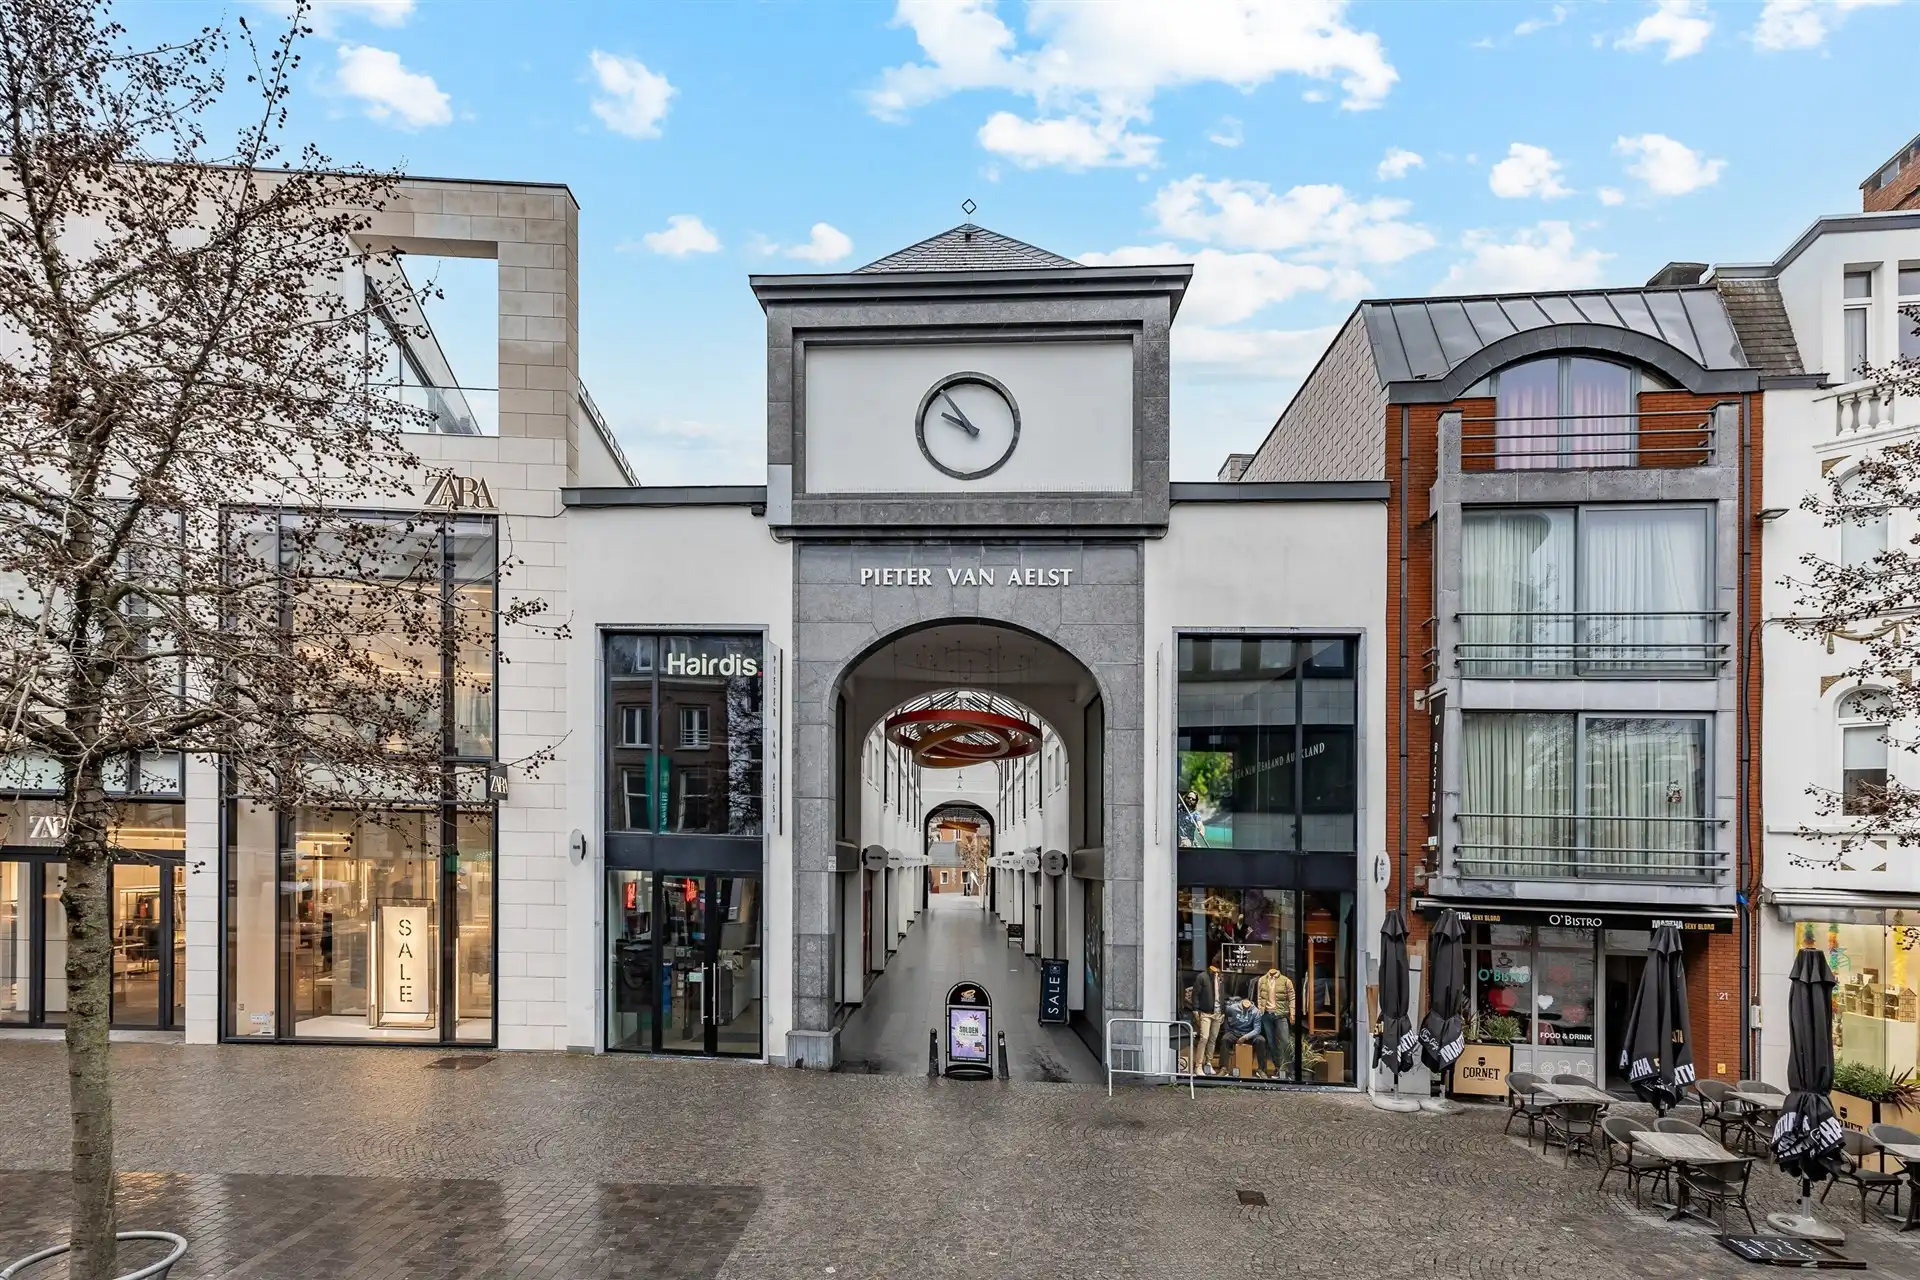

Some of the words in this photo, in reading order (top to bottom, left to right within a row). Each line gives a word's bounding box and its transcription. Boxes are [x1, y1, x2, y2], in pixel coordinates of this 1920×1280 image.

[424, 476, 496, 508] ZARA
[860, 568, 932, 586] PIETER
[946, 568, 994, 586] VAN
[1007, 568, 1073, 586] AELST
[490, 774, 509, 793] ZARA
[398, 919, 413, 1002] SALE
[1047, 977, 1060, 1014] SALE
[1569, 1033, 1592, 1041] DRINK
[1463, 1066, 1500, 1080] CORNET
